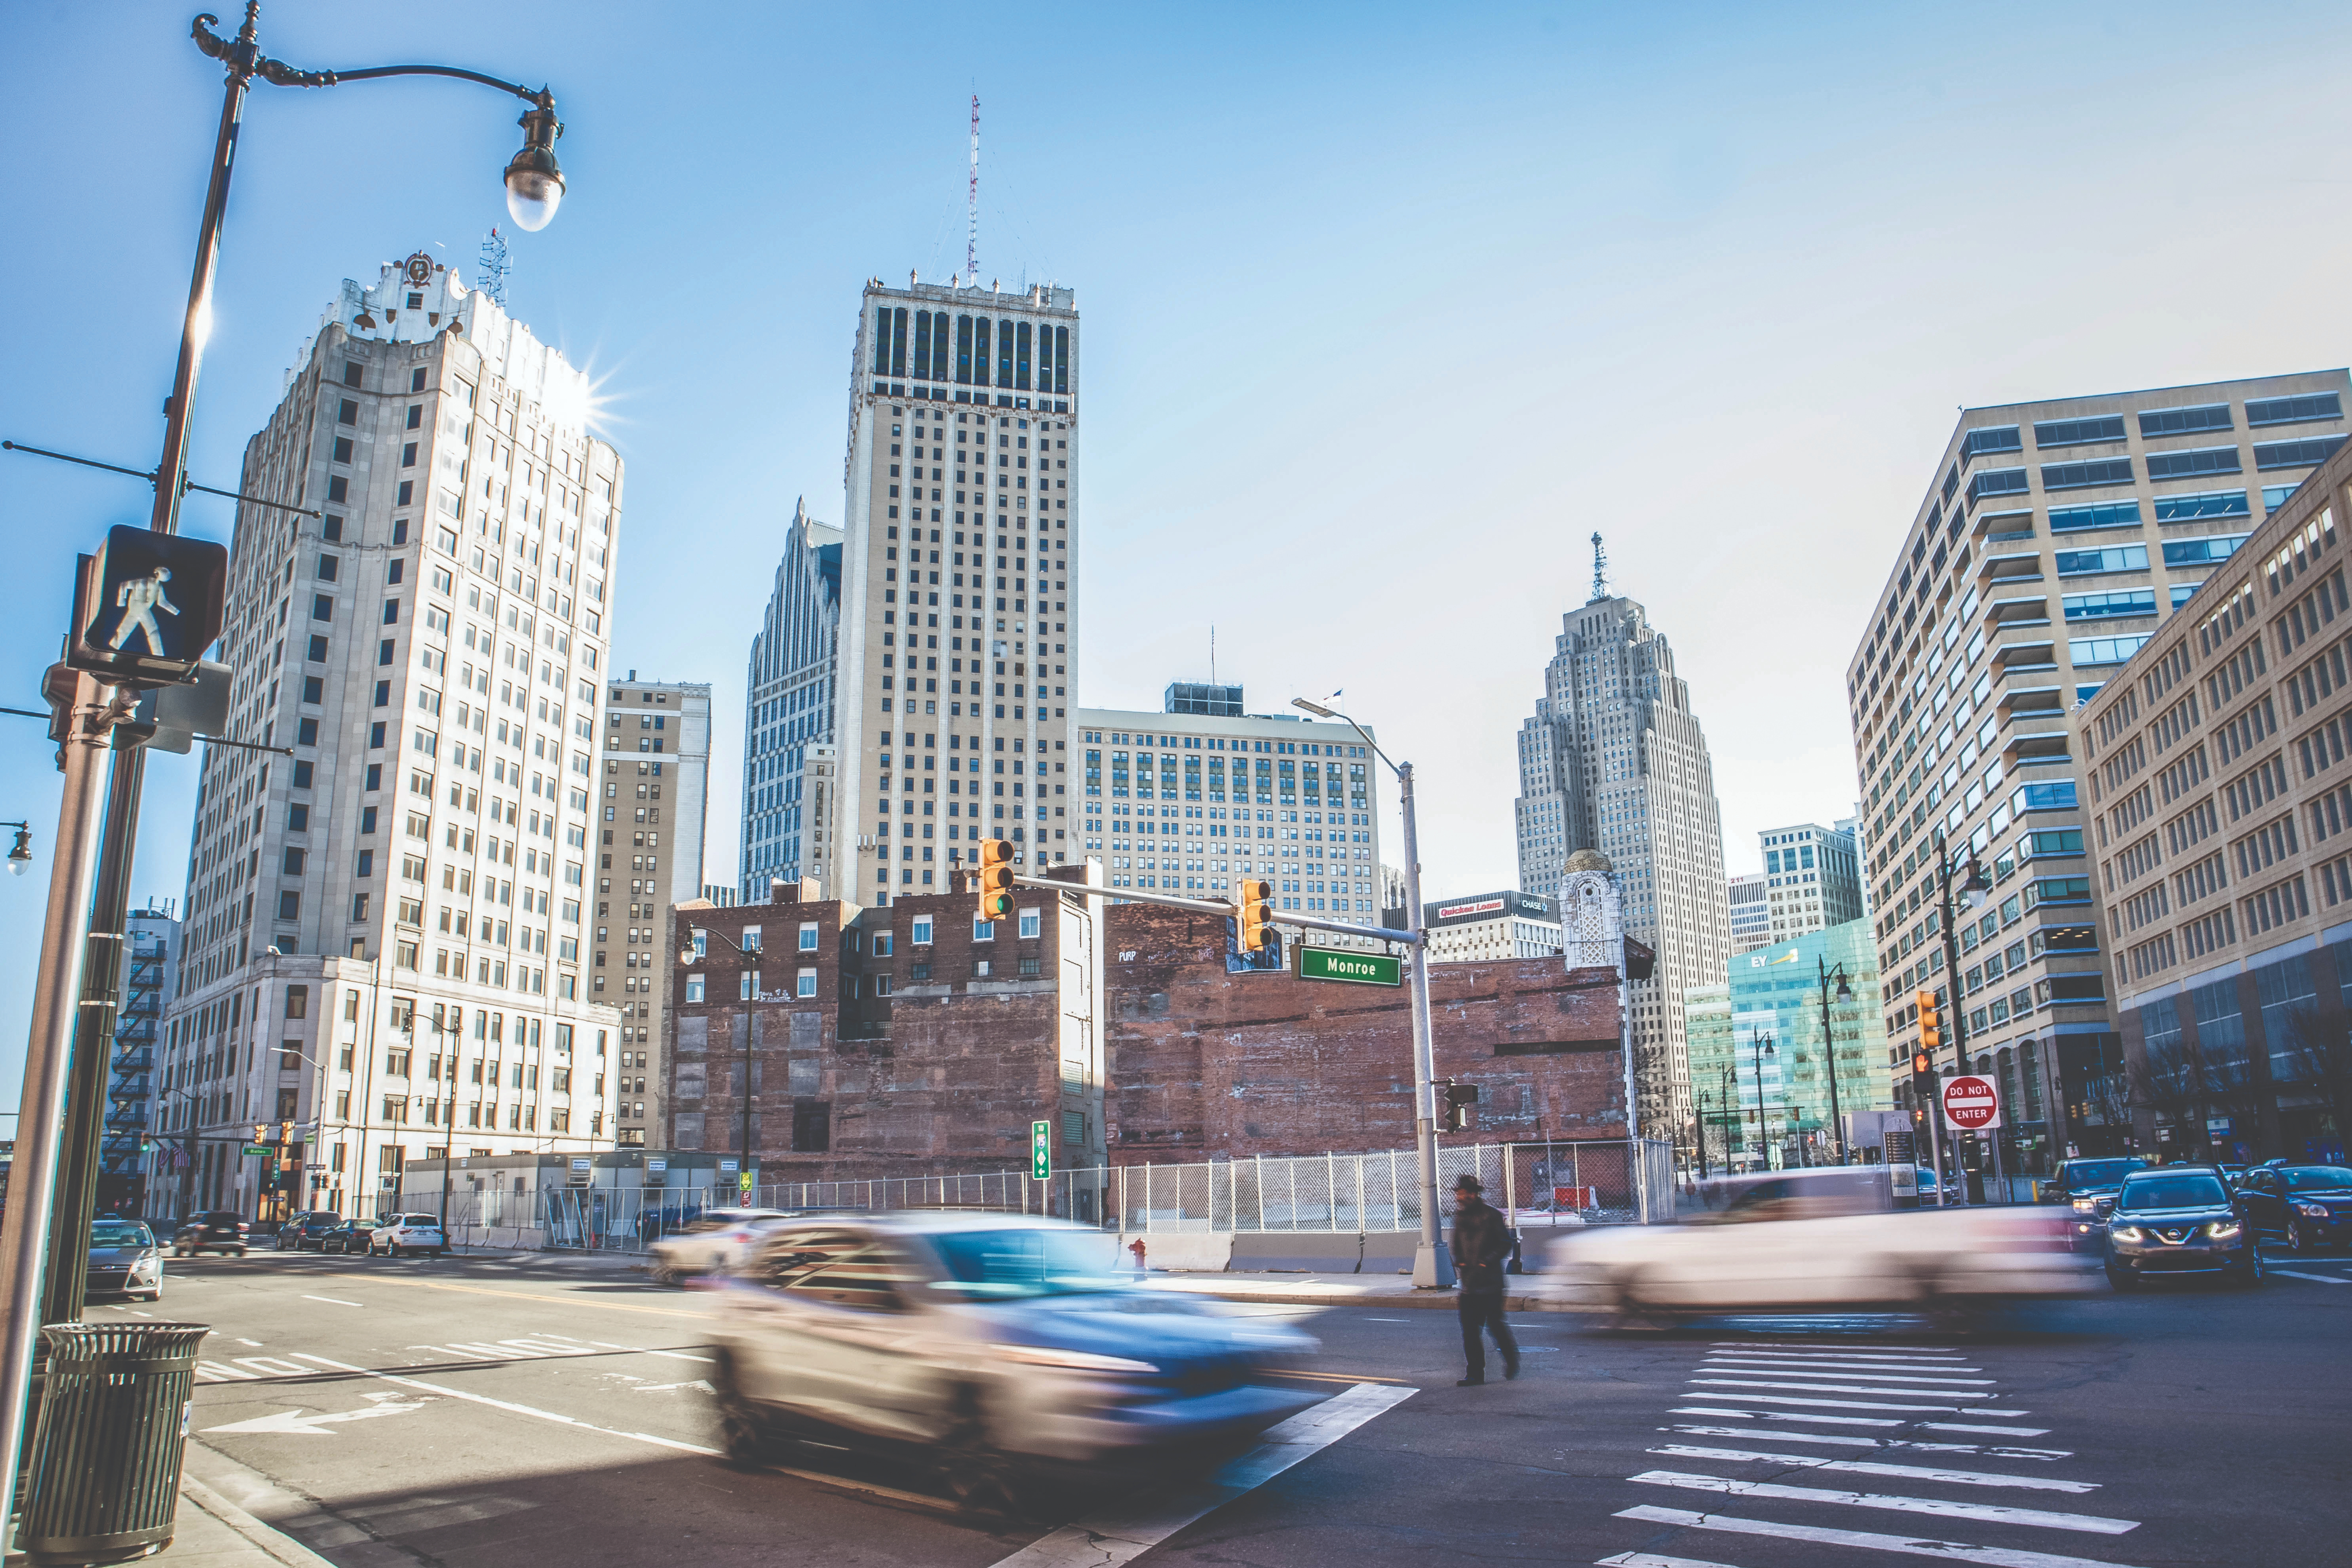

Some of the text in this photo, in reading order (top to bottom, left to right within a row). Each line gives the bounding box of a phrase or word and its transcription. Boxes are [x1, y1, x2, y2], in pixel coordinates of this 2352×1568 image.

[1440, 901, 1502, 917] Quicken Loans
[1522, 900, 1542, 911] CHASE
[1119, 951, 1136, 962] PURP
[1751, 955, 1768, 968] EY
[1327, 957, 1376, 975] Monroe
[1949, 1086, 1988, 1096] DO NOT
[1956, 1109, 1987, 1119] ENTER
[1037, 1139, 1045, 1147] 75
